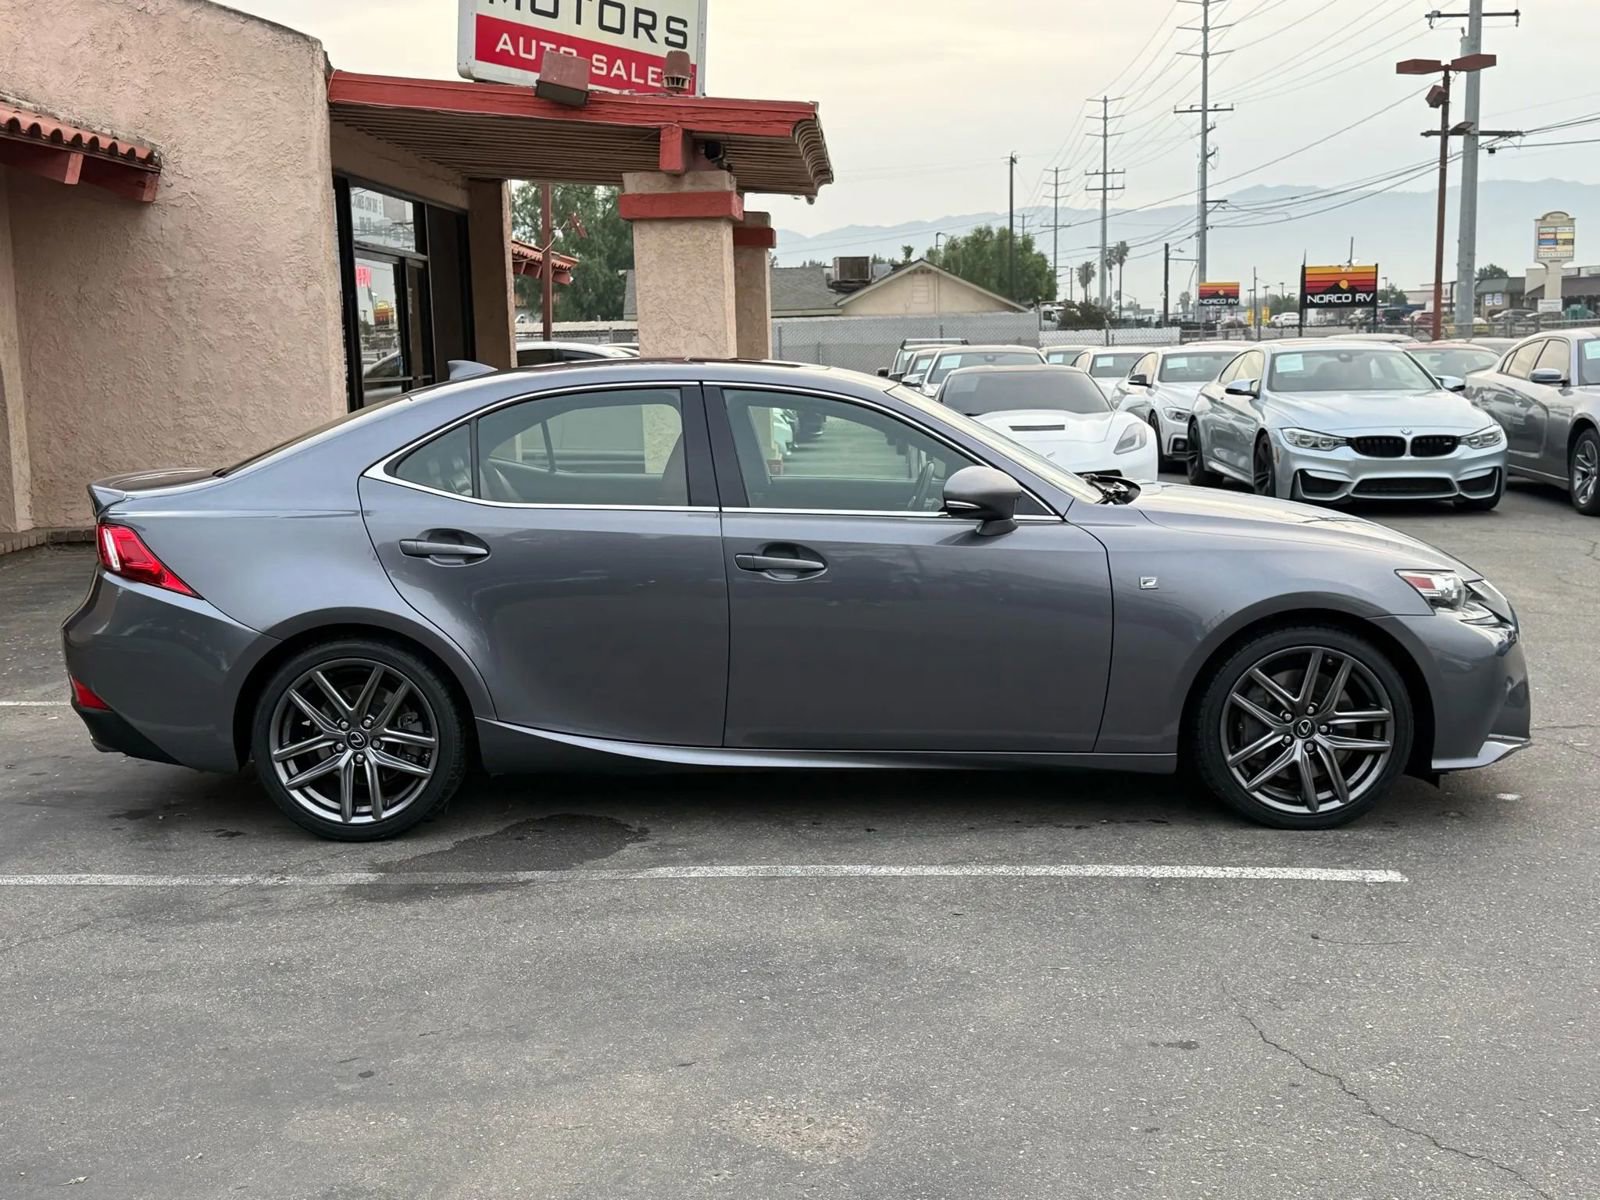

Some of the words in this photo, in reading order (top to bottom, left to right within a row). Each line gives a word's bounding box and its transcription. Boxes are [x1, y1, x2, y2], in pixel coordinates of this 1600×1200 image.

[488, 0, 688, 50] OTORS
[591, 53, 663, 88] SALE
[1306, 293, 1352, 304] NORCO
[1355, 292, 1374, 303] RV
